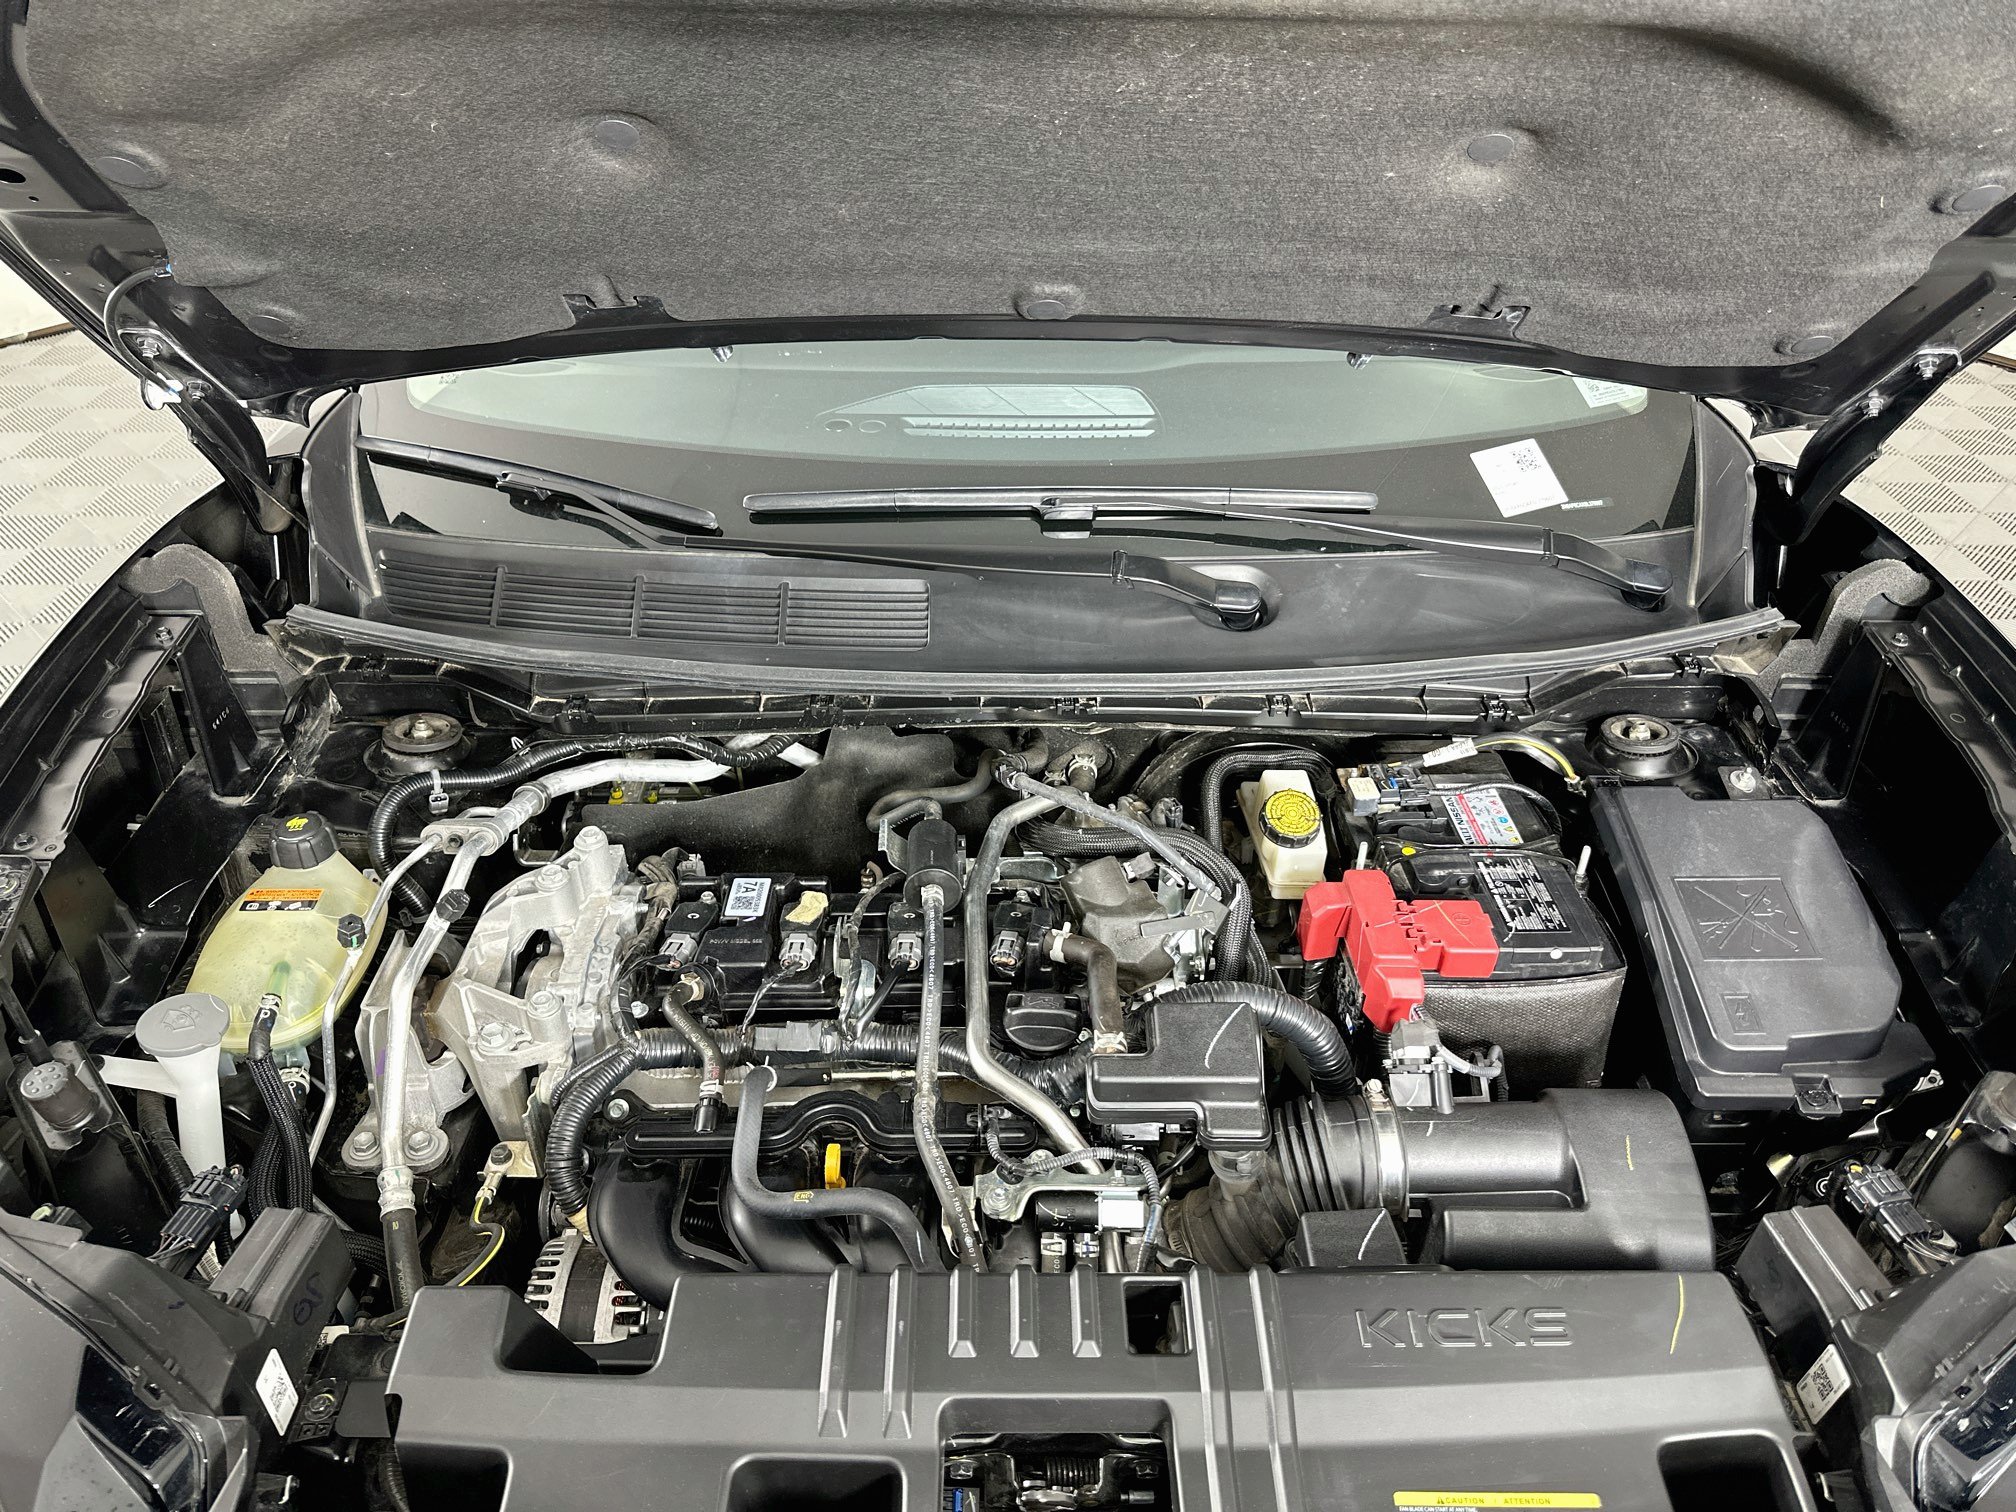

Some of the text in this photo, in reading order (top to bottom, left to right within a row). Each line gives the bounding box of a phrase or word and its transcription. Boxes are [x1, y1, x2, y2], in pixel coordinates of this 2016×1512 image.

[1446, 797, 1463, 826] NISSAN
[741, 881, 759, 894] 7A
[1354, 1307, 1573, 1347] KICKS
[1445, 1497, 1551, 1505] CAUTION ATTENTION
